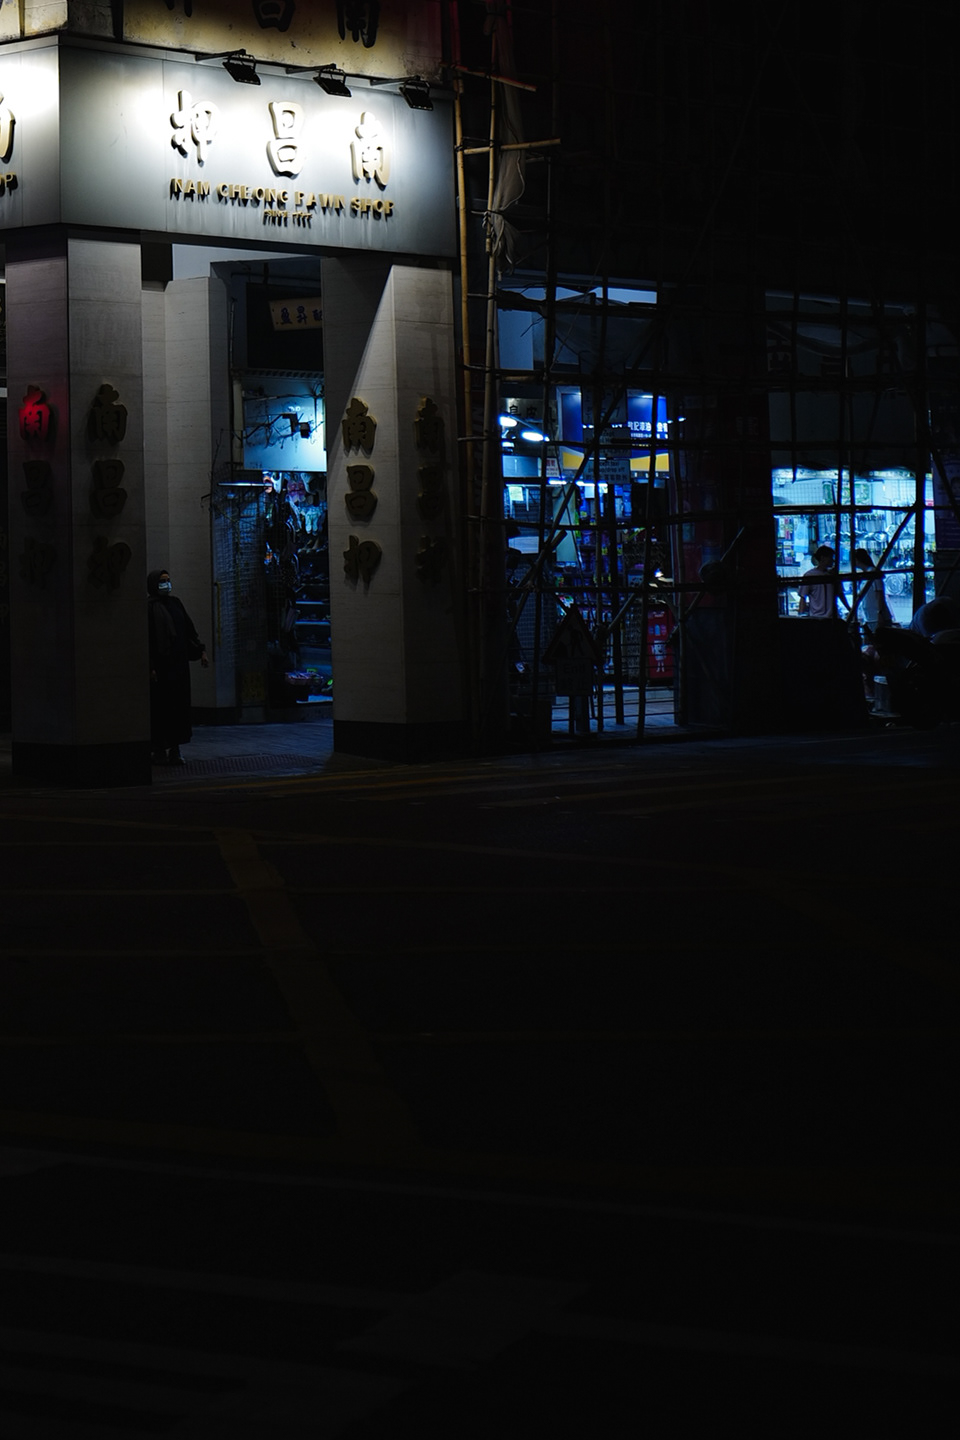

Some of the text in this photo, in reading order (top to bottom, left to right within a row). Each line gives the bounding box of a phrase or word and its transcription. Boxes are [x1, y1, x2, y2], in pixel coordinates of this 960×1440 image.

[170, 177, 394, 215] NAM CHEONG PAWN SHOP
